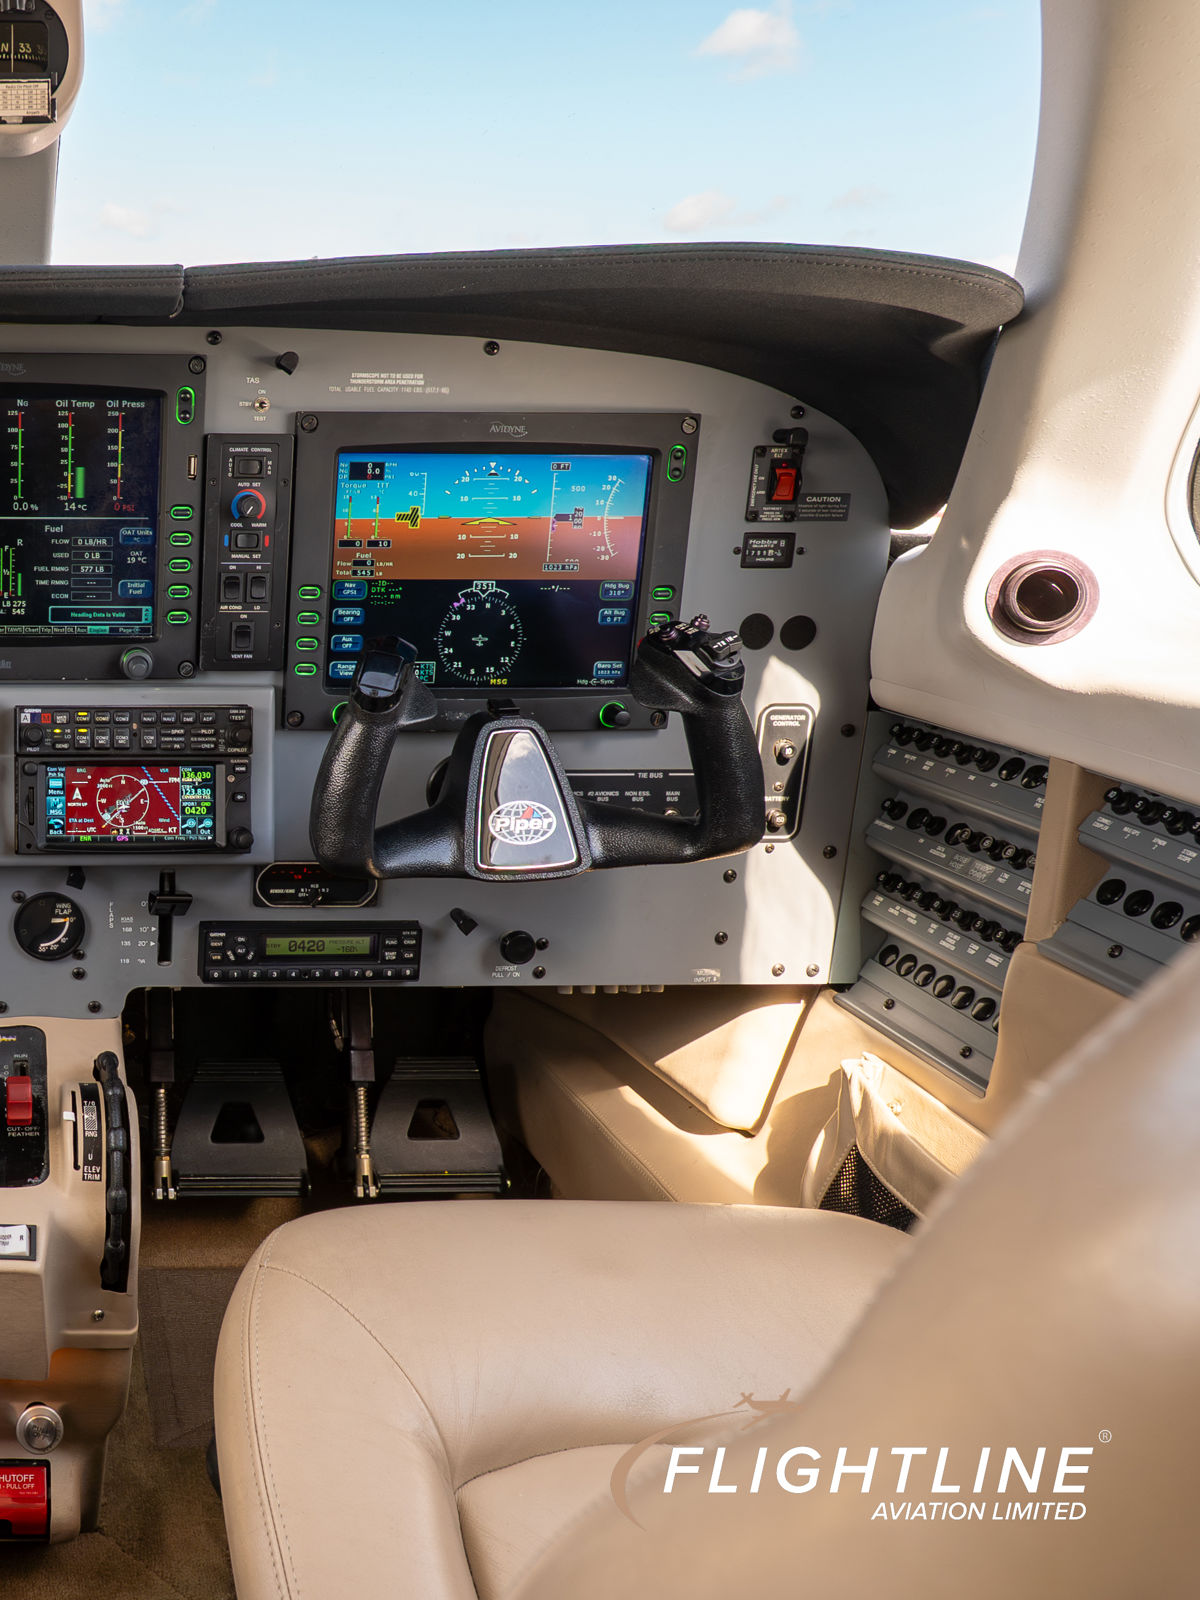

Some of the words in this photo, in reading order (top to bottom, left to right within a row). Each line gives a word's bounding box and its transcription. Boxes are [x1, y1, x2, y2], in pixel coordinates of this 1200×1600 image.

[0, 43, 9, 52] N
[18, 43, 32, 53] 33
[56, 400, 68, 408] Oil
[71, 400, 95, 408] Temp
[489, 424, 526, 434] AVIDYNE
[14, 502, 28, 510] 0.0
[64, 502, 76, 510] 14
[494, 816, 554, 834] Piper
[288, 940, 325, 952] 0420
